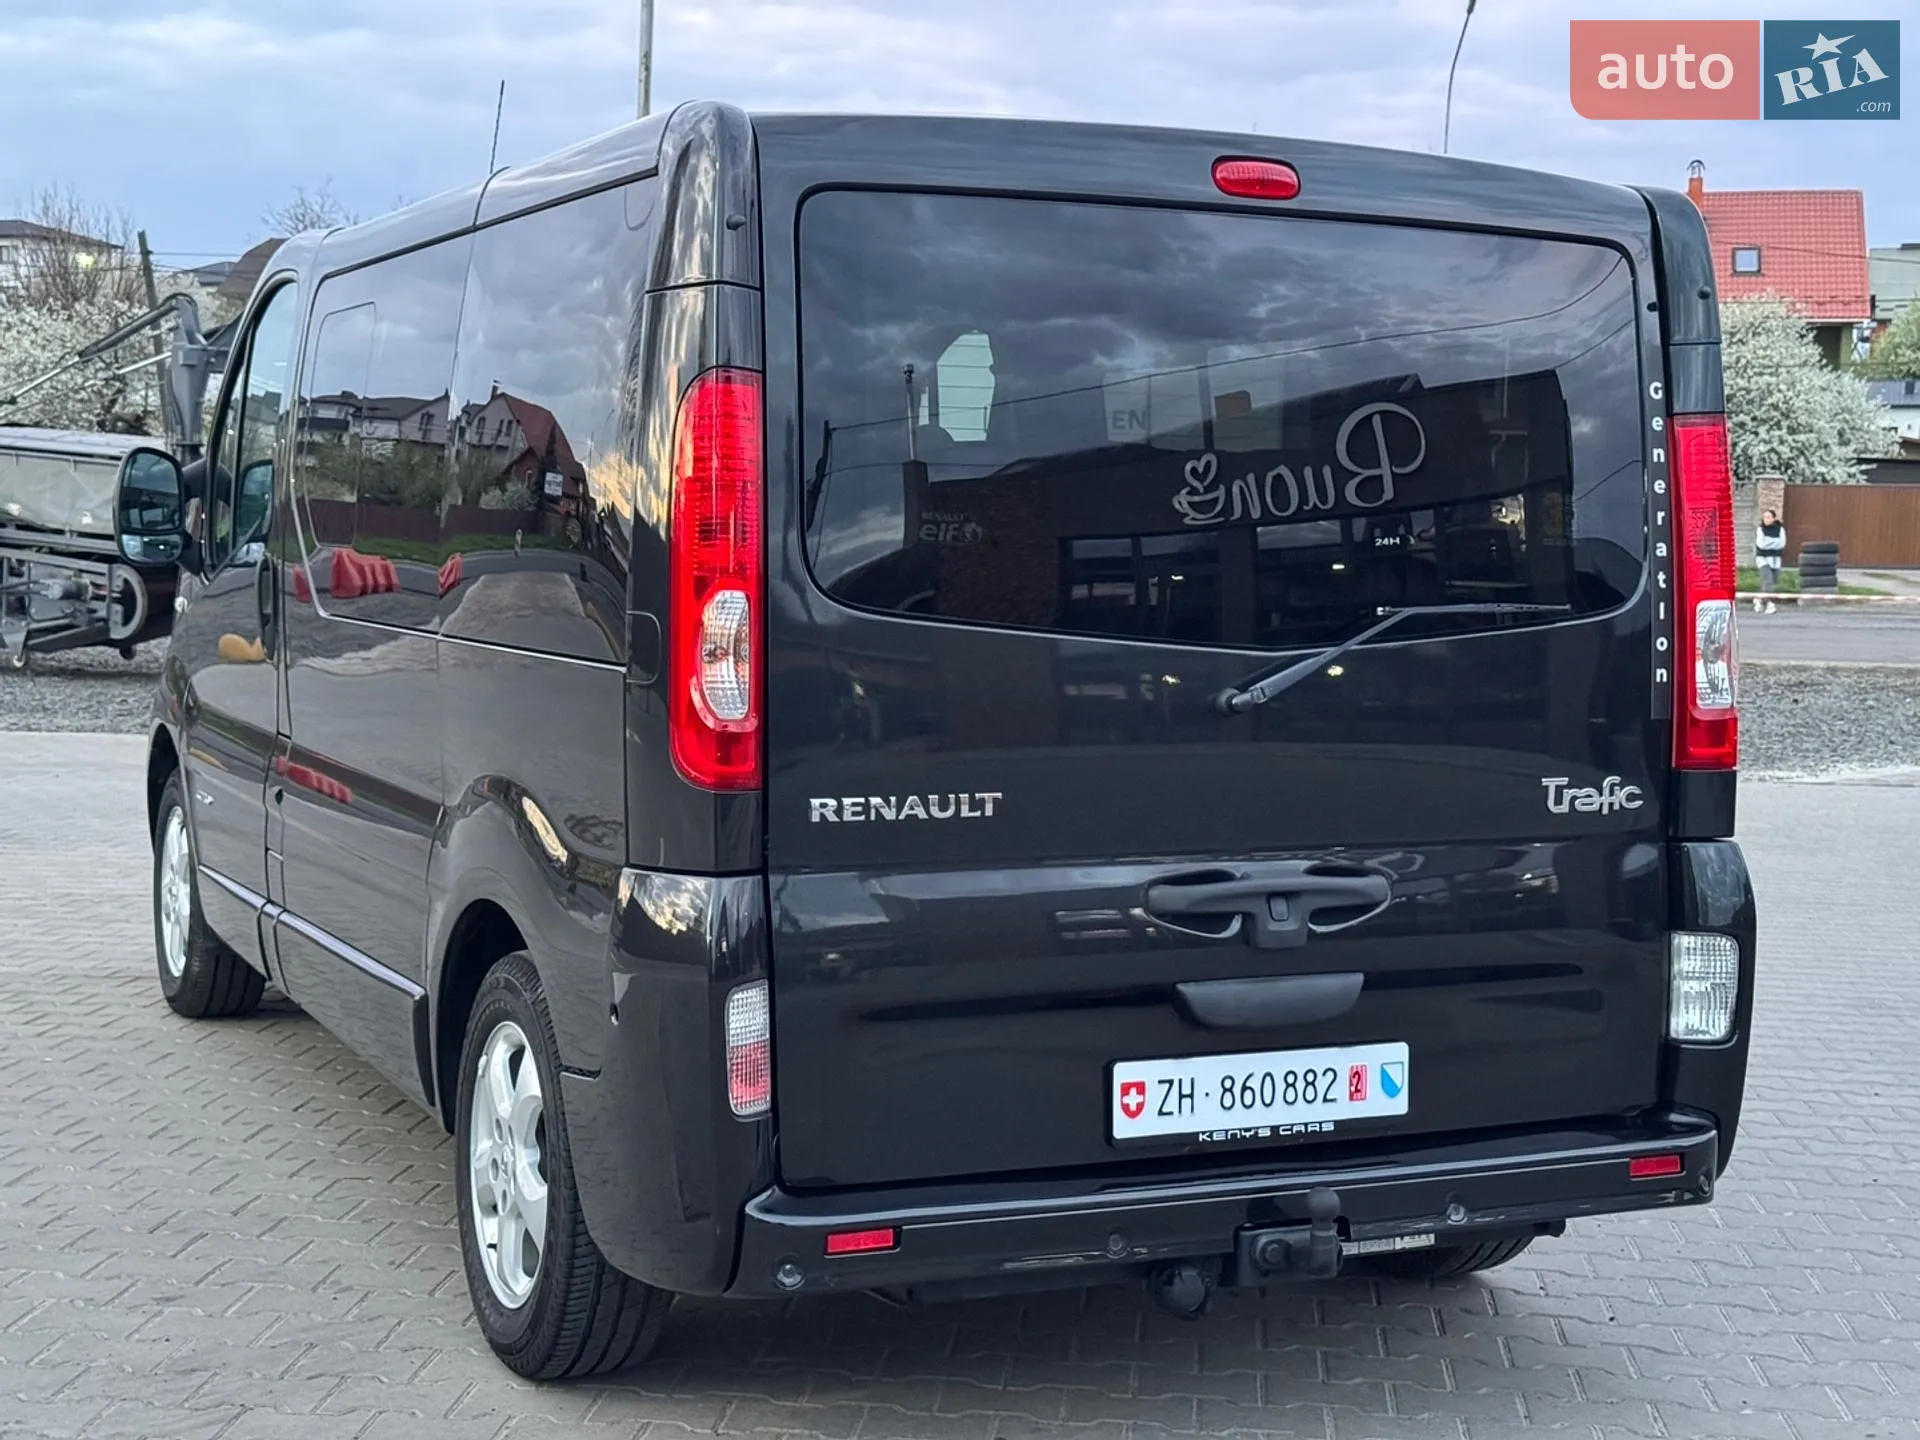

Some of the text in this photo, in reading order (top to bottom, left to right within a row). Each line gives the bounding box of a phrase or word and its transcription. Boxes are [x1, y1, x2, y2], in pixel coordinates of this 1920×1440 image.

[1112, 410, 1146, 431] EN
[1375, 536, 1400, 547] 24H
[1541, 775, 1644, 815] Trafic
[808, 792, 1003, 823] RENAULT
[1279, 1121, 1335, 1135] CARS
